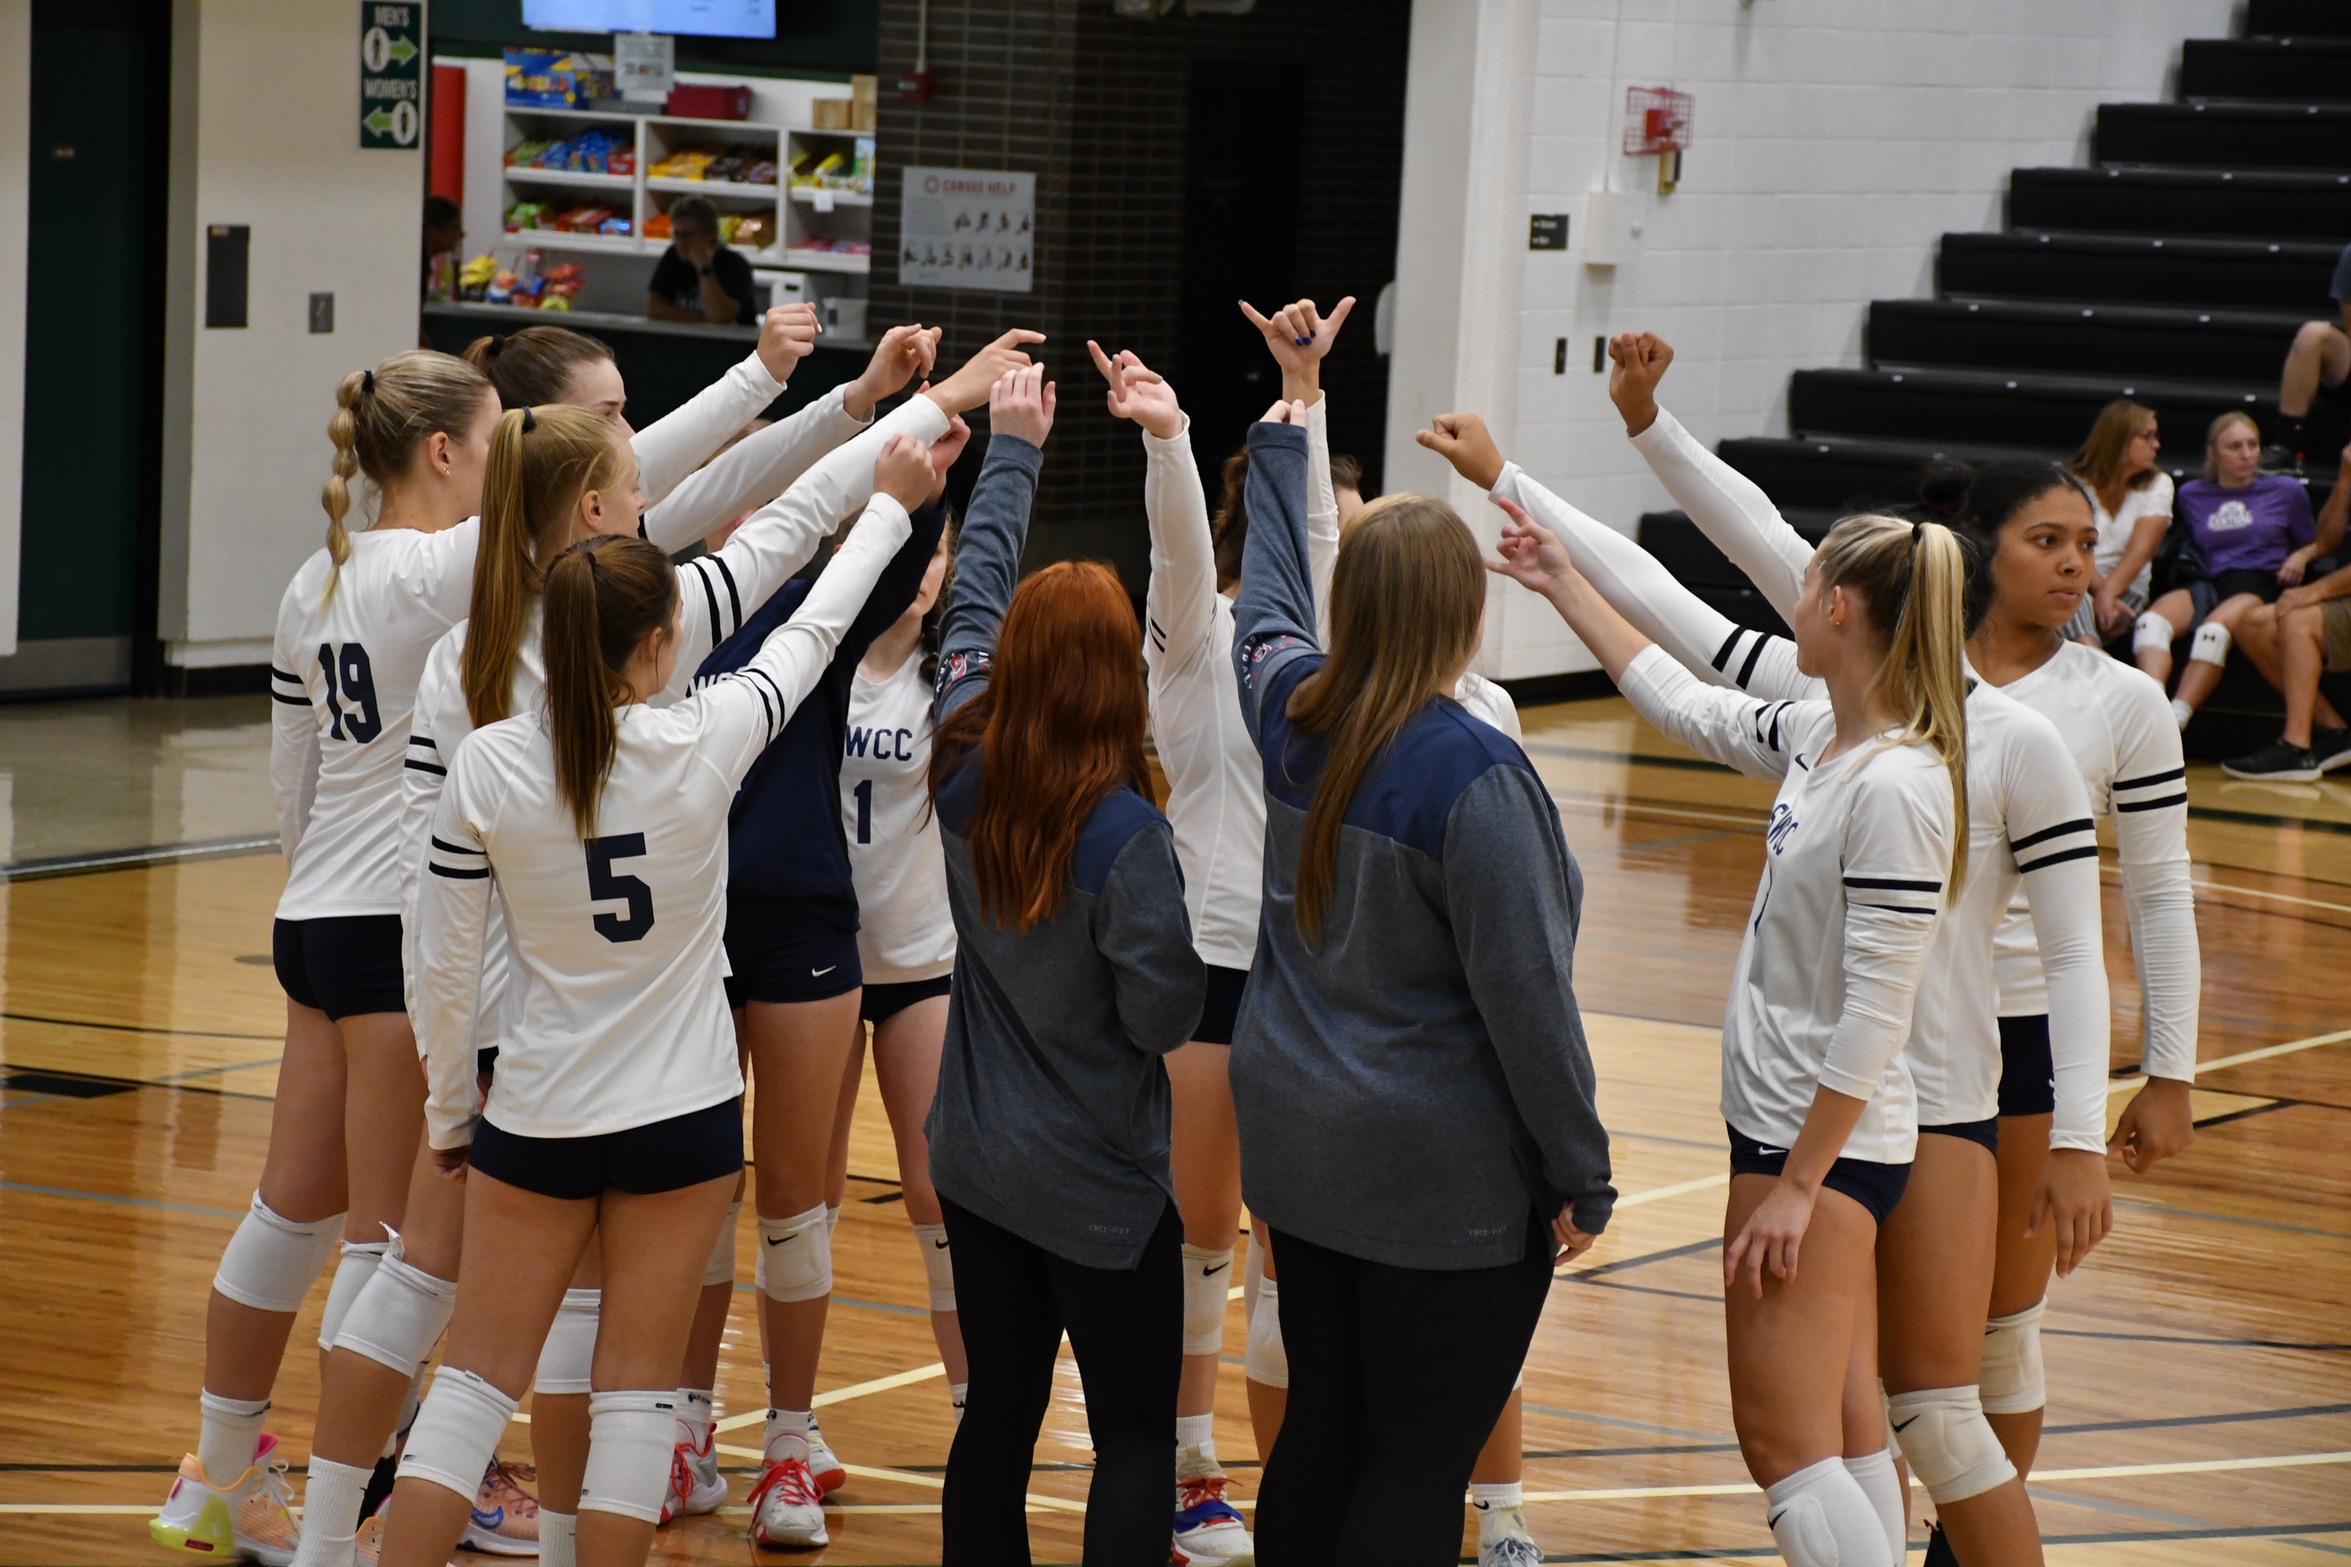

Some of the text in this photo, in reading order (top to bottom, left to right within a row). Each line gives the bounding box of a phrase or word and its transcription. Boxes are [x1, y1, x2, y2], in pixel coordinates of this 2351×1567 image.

[374, 5, 410, 27] MEN'S
[364, 78, 418, 99] WOMEN'S
[318, 642, 382, 744] 19
[845, 725, 912, 761] WCC
[854, 779, 872, 844] 1
[584, 832, 655, 943] 5
